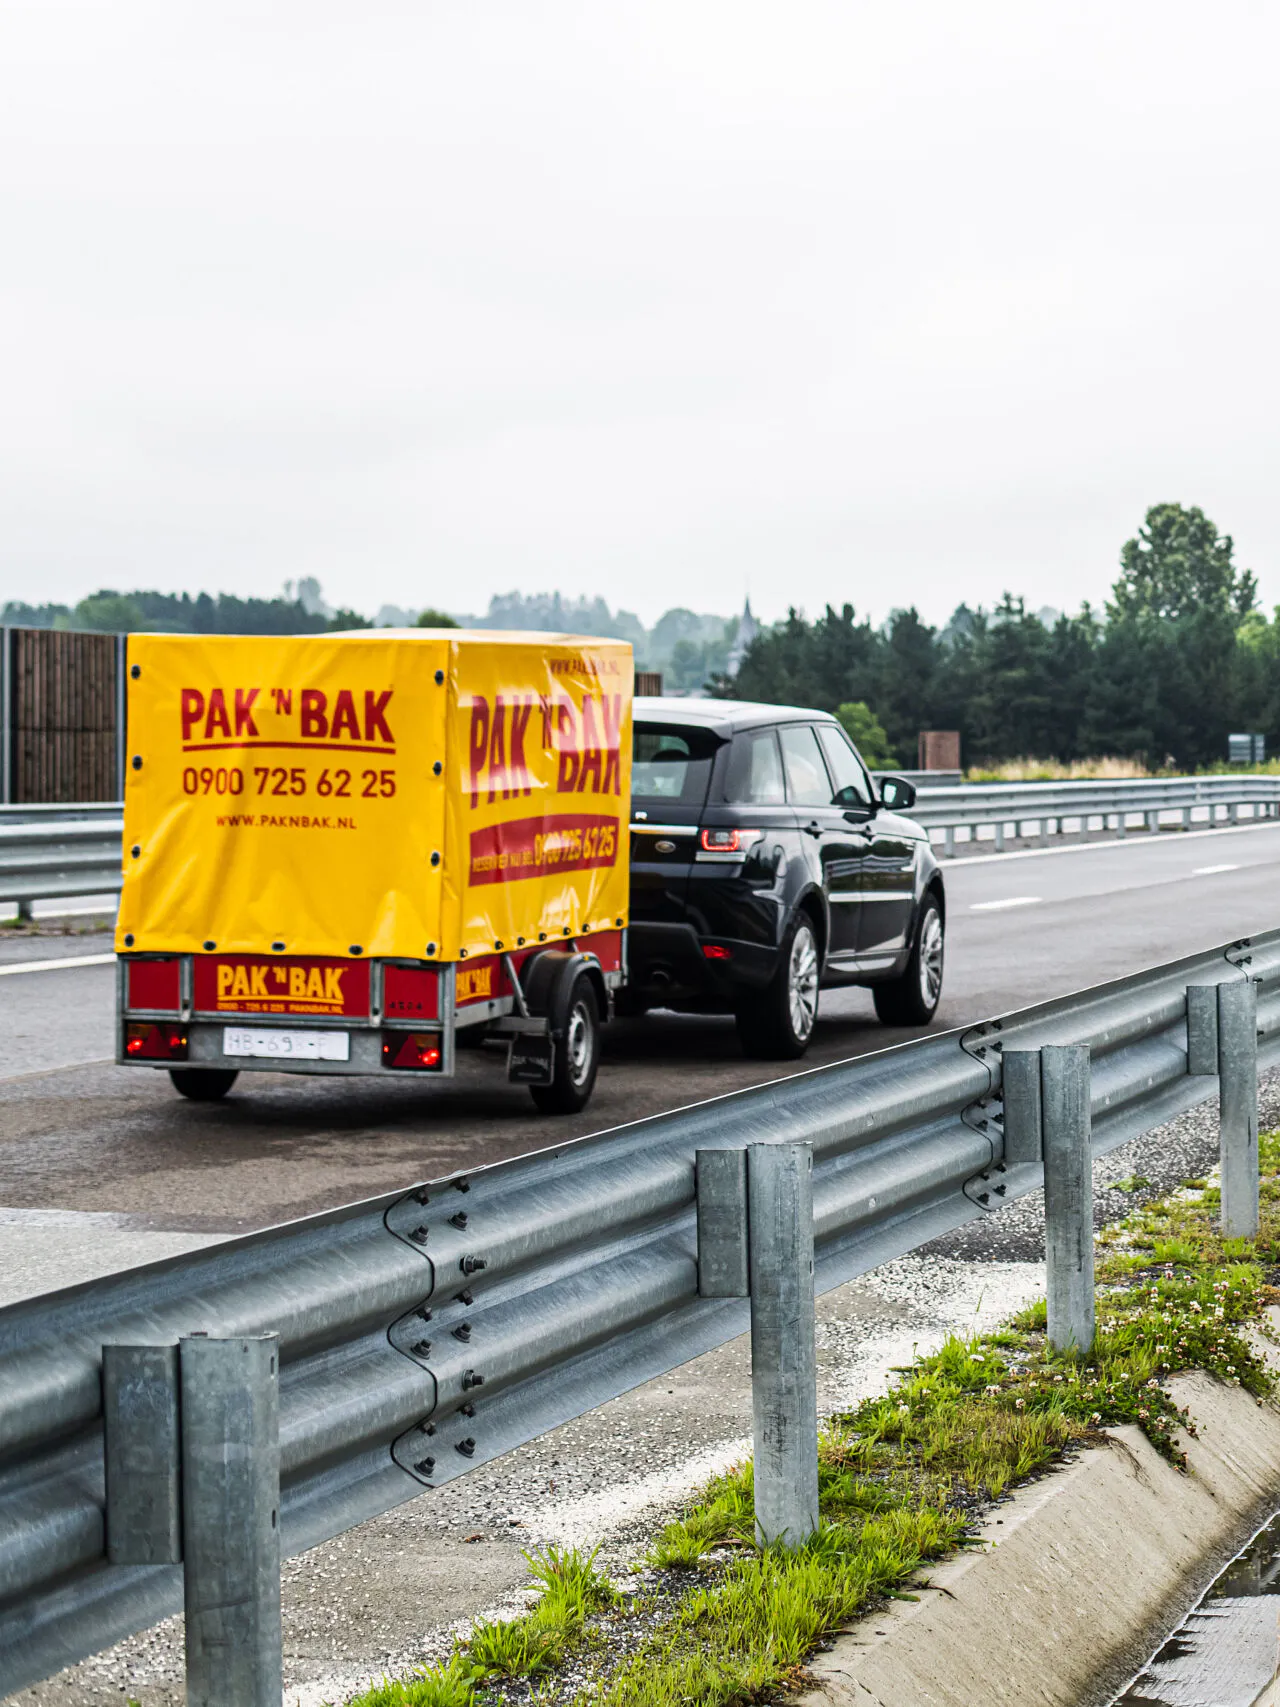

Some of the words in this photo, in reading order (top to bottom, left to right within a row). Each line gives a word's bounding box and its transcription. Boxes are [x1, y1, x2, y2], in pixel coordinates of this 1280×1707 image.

[181, 688, 261, 741] PAK
[300, 689, 396, 743] BAK
[470, 695, 533, 810] PAK
[556, 694, 621, 797] BAK
[182, 767, 244, 795] 0900
[253, 767, 307, 796] 725
[316, 769, 352, 798] 62
[361, 770, 396, 799] 25
[216, 815, 358, 830] WWW.PAKNBAK.NL
[217, 965, 270, 997] PAK
[288, 966, 345, 1001] BAK
